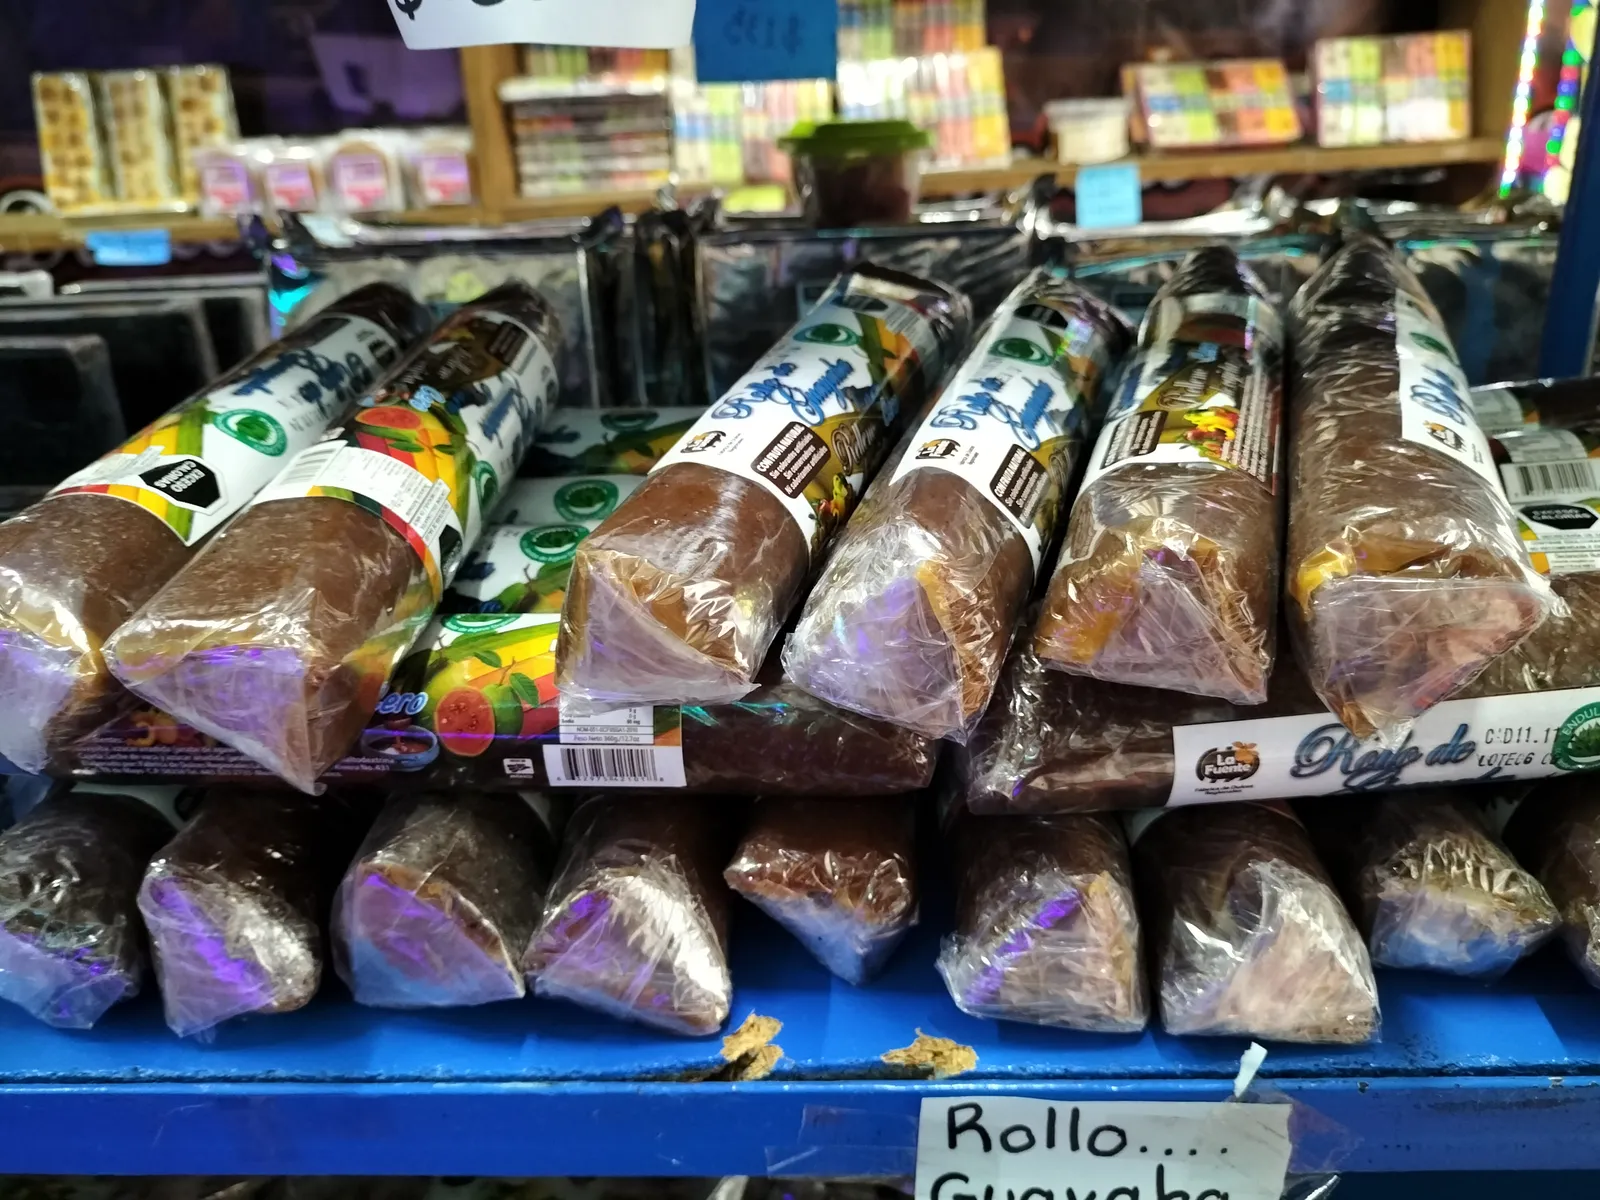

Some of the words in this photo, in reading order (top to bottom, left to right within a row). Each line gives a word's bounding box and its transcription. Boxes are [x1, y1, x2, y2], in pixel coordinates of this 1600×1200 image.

[755, 456, 772, 473] CON
[766, 441, 786, 462] FRUTA
[779, 421, 805, 448] NATURAL
[170, 468, 206, 492] EXCESO
[375, 691, 429, 715] ero
[1424, 723, 1477, 767] de
[1204, 763, 1252, 776] Fuente
[1216, 754, 1235, 766] La
